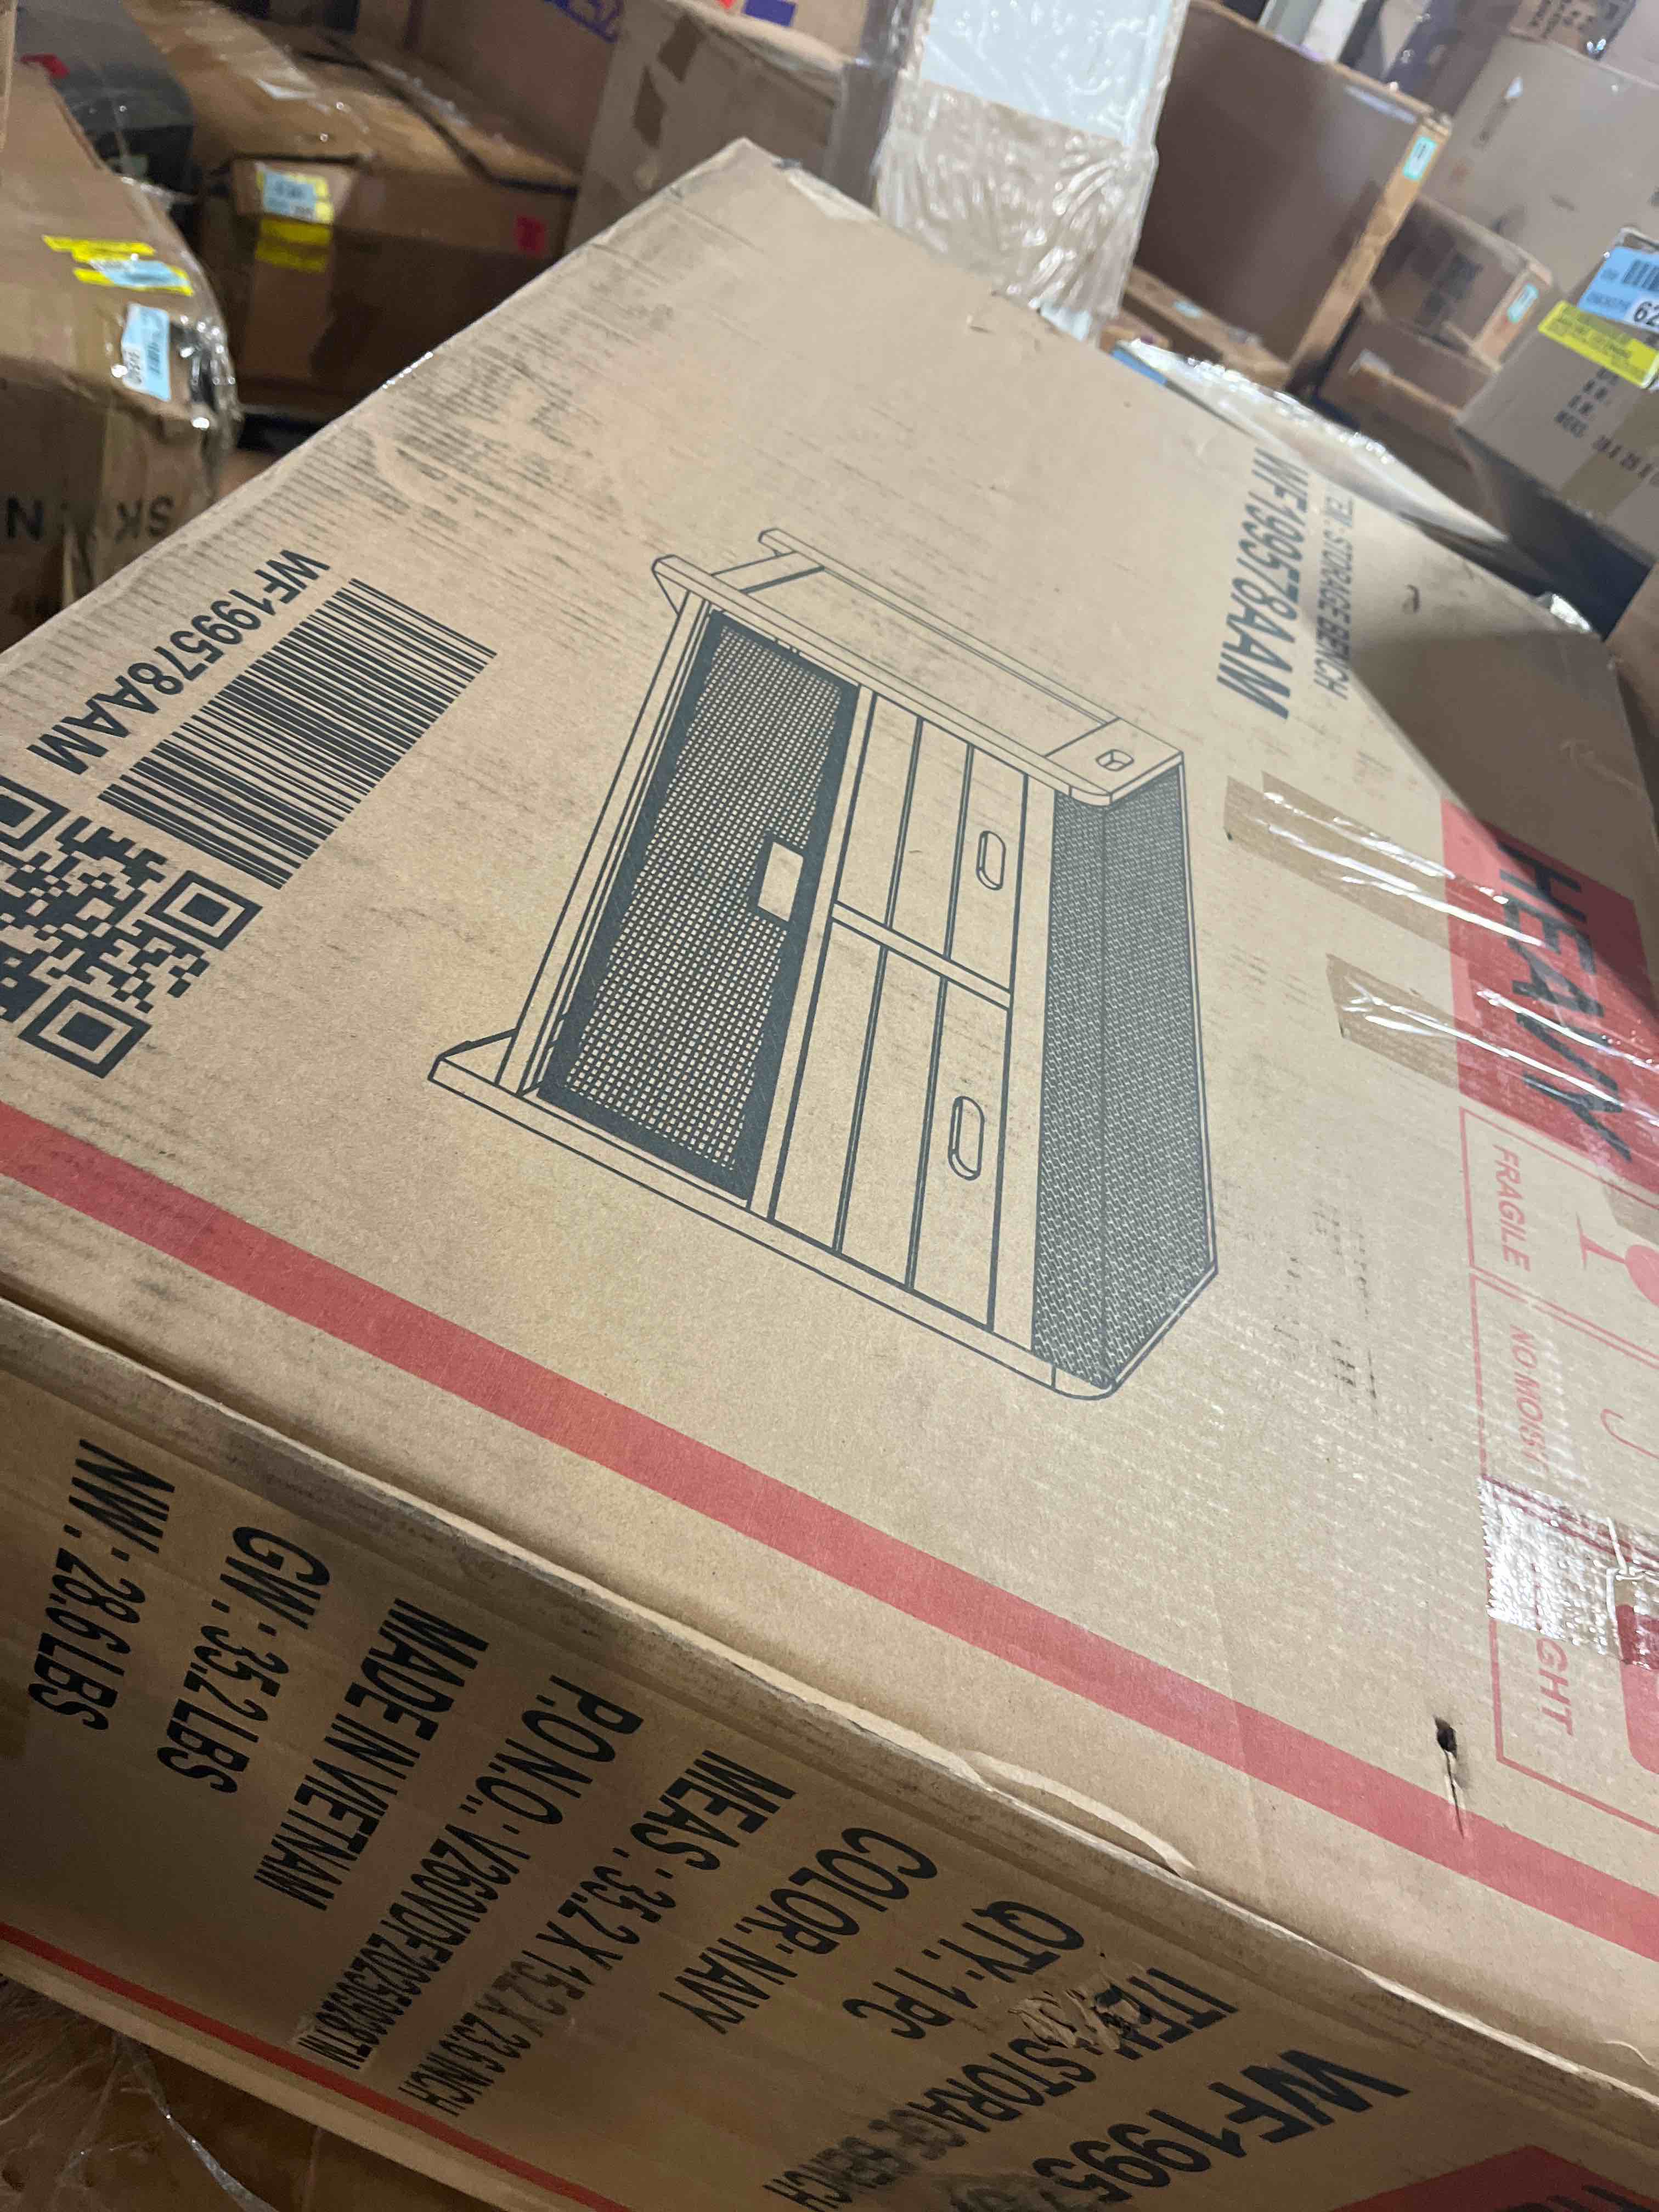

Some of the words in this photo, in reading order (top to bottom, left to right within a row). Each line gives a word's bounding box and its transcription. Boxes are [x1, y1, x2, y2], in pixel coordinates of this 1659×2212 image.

[1216, 447, 1308, 720] WF199578AAM
[1318, 529, 1352, 625] STORAGE
[26, 549, 330, 775] WF199578AAM
[1313, 616, 1351, 701] BENCH
[1497, 840, 1633, 1163] HEAVY
[1493, 1144, 1531, 1272] FRAGILE
[1510, 1324, 1537, 1370] NO
[344, 1597, 489, 1741] MADE
[324, 1712, 421, 1780] IN
[253, 1758, 389, 1911] VIETNAM
[535, 1920, 624, 1971] X
[557, 1865, 676, 1944] 35.2
[658, 1937, 798, 2034] NAVY
[398, 2052, 494, 2118] INCH
[868, 2038, 1097, 2160] STORAGE
[952, 2049, 1412, 2212] WF1995
